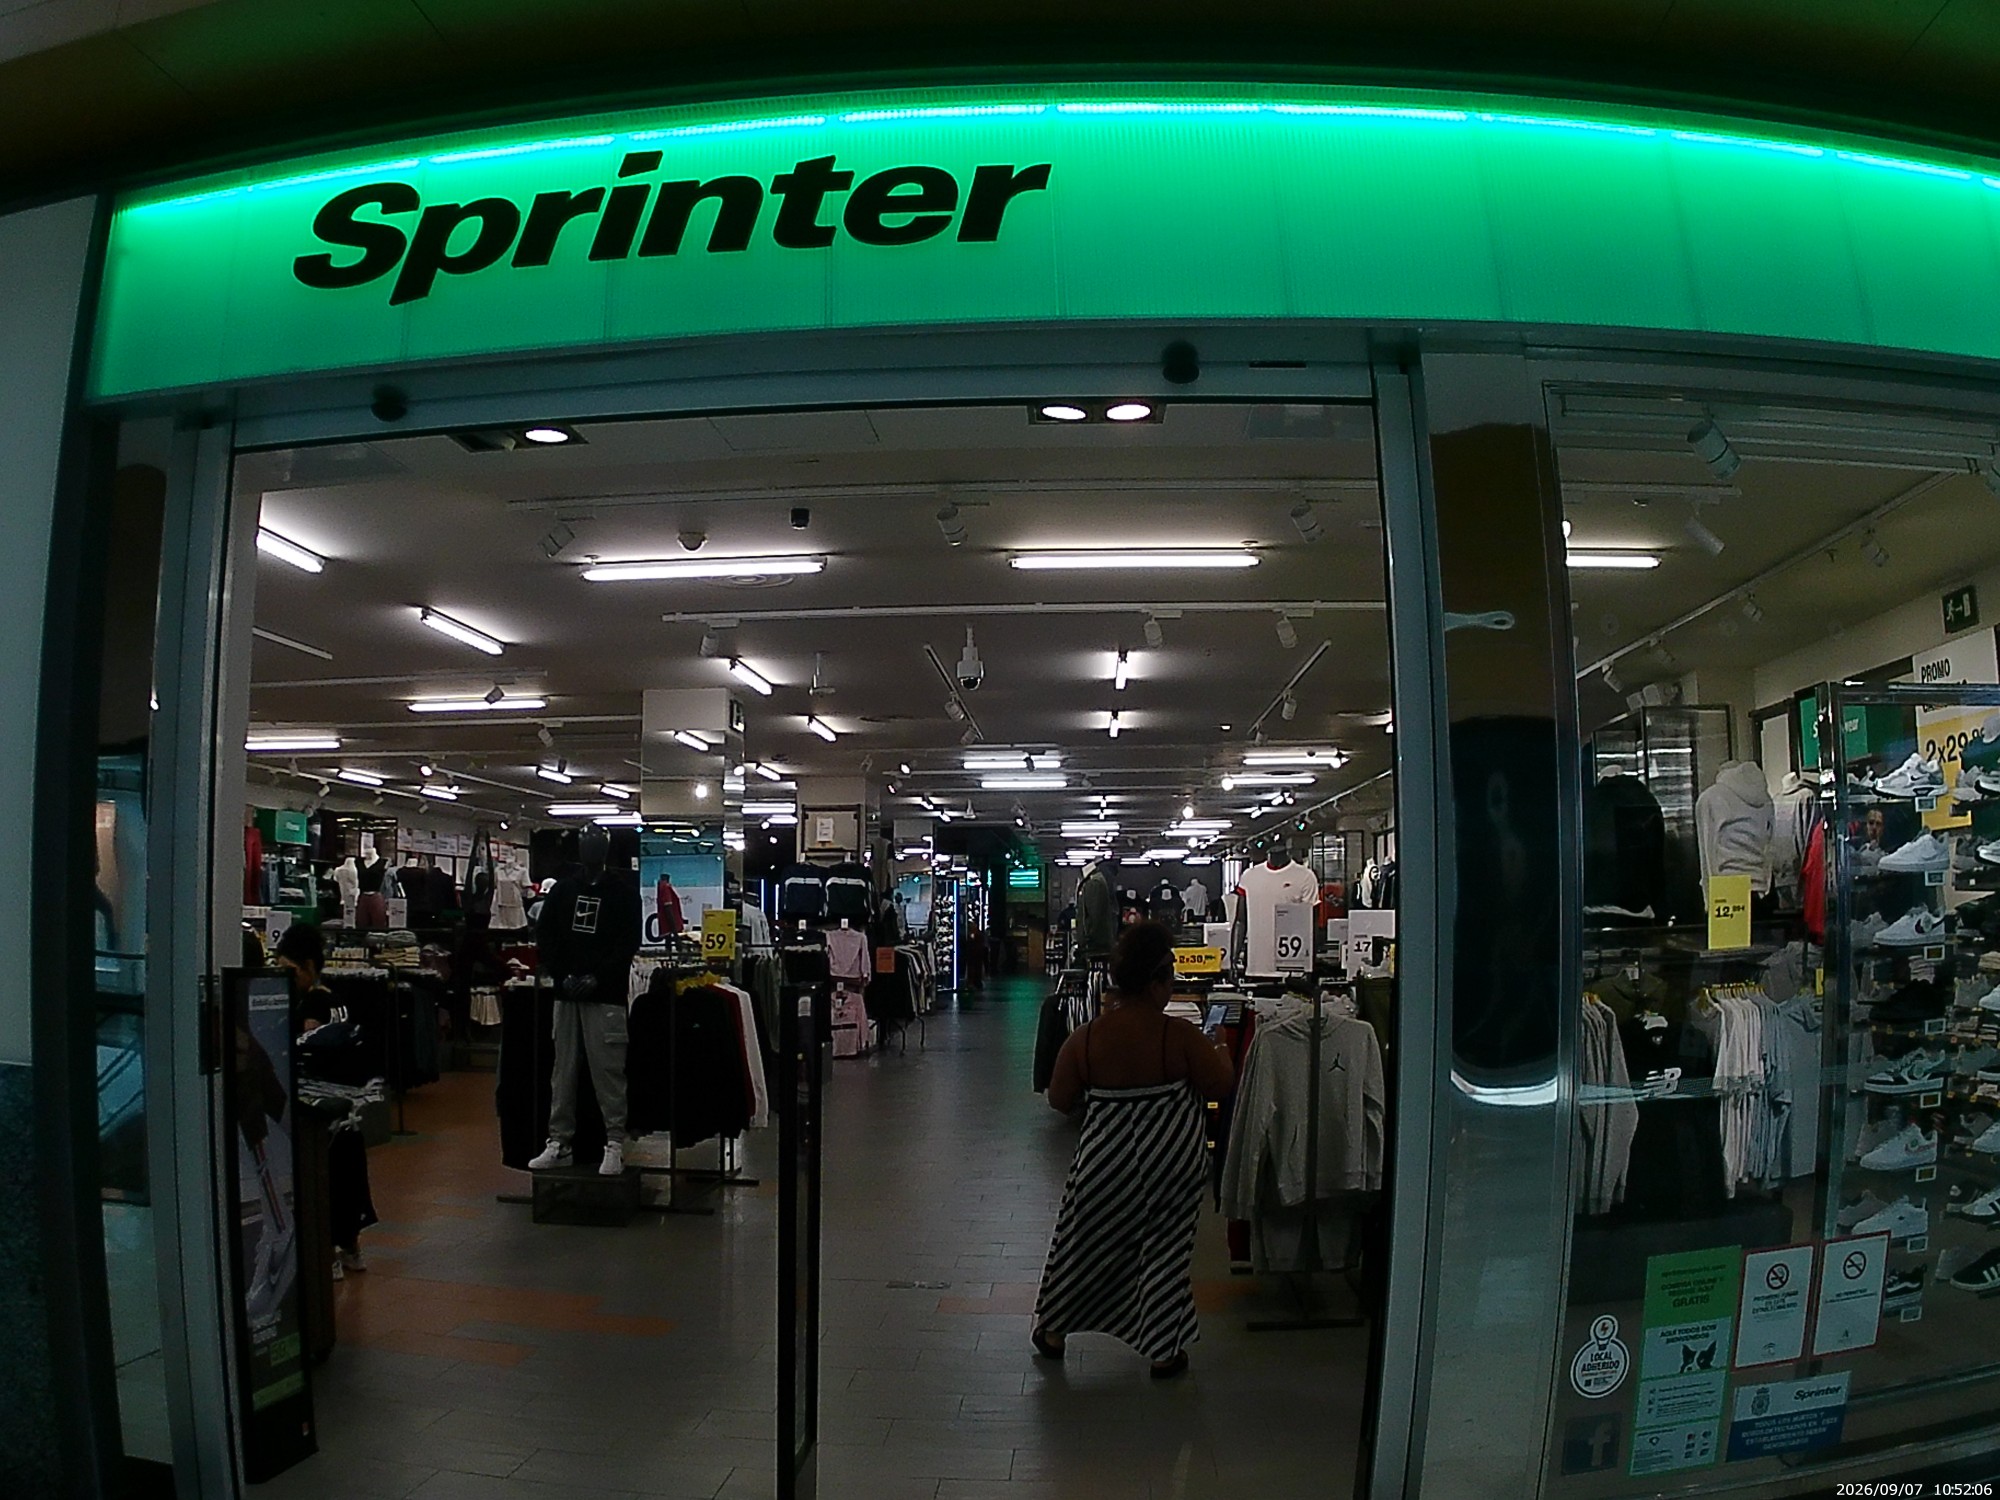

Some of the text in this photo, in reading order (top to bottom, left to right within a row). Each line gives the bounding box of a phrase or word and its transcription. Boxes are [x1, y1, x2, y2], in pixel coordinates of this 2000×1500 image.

[292, 151, 1052, 305] Sprinter
[1921, 658, 1950, 685] PROMO
[705, 933, 726, 950] 59
[1278, 936, 1302, 958] 59
[1672, 1294, 1710, 1308] GRATIS
[1591, 1351, 1613, 1362] LOCAL
[1794, 1386, 1842, 1401] Sprinter
